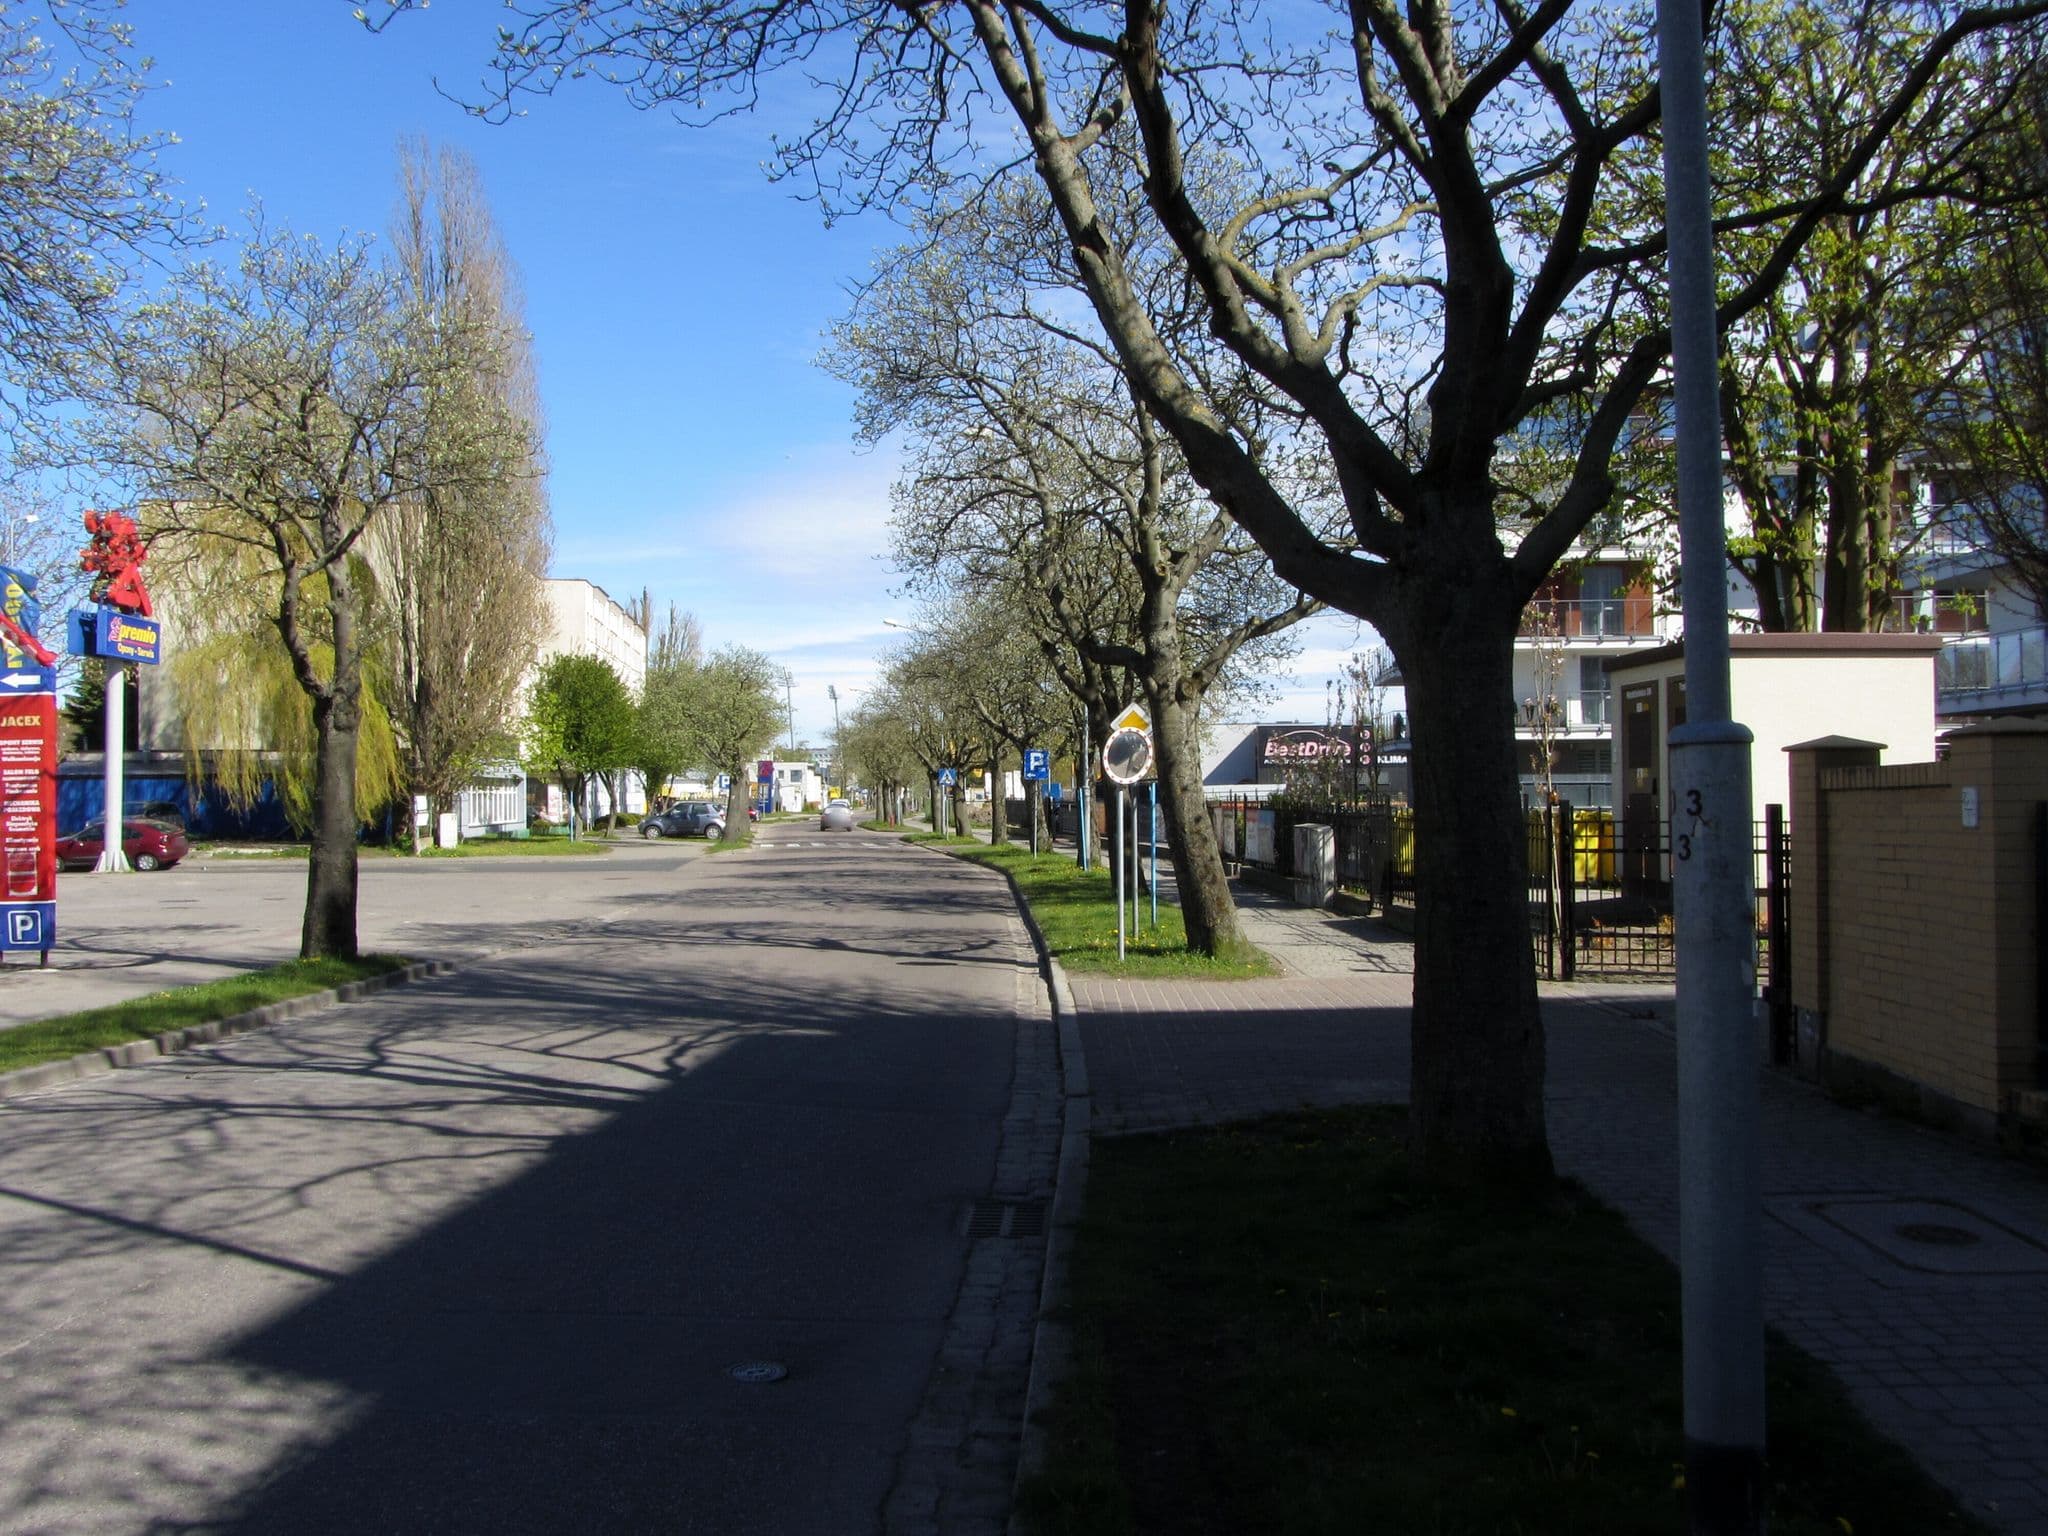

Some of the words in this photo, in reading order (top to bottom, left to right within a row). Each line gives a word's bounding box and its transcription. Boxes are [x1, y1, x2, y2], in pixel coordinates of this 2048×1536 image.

[119, 624, 156, 644] premio
[1, 715, 41, 727] JACEX
[1030, 752, 1044, 770] P
[1686, 789, 1702, 816] 3
[1678, 834, 1691, 861] 3
[15, 914, 34, 940] P
